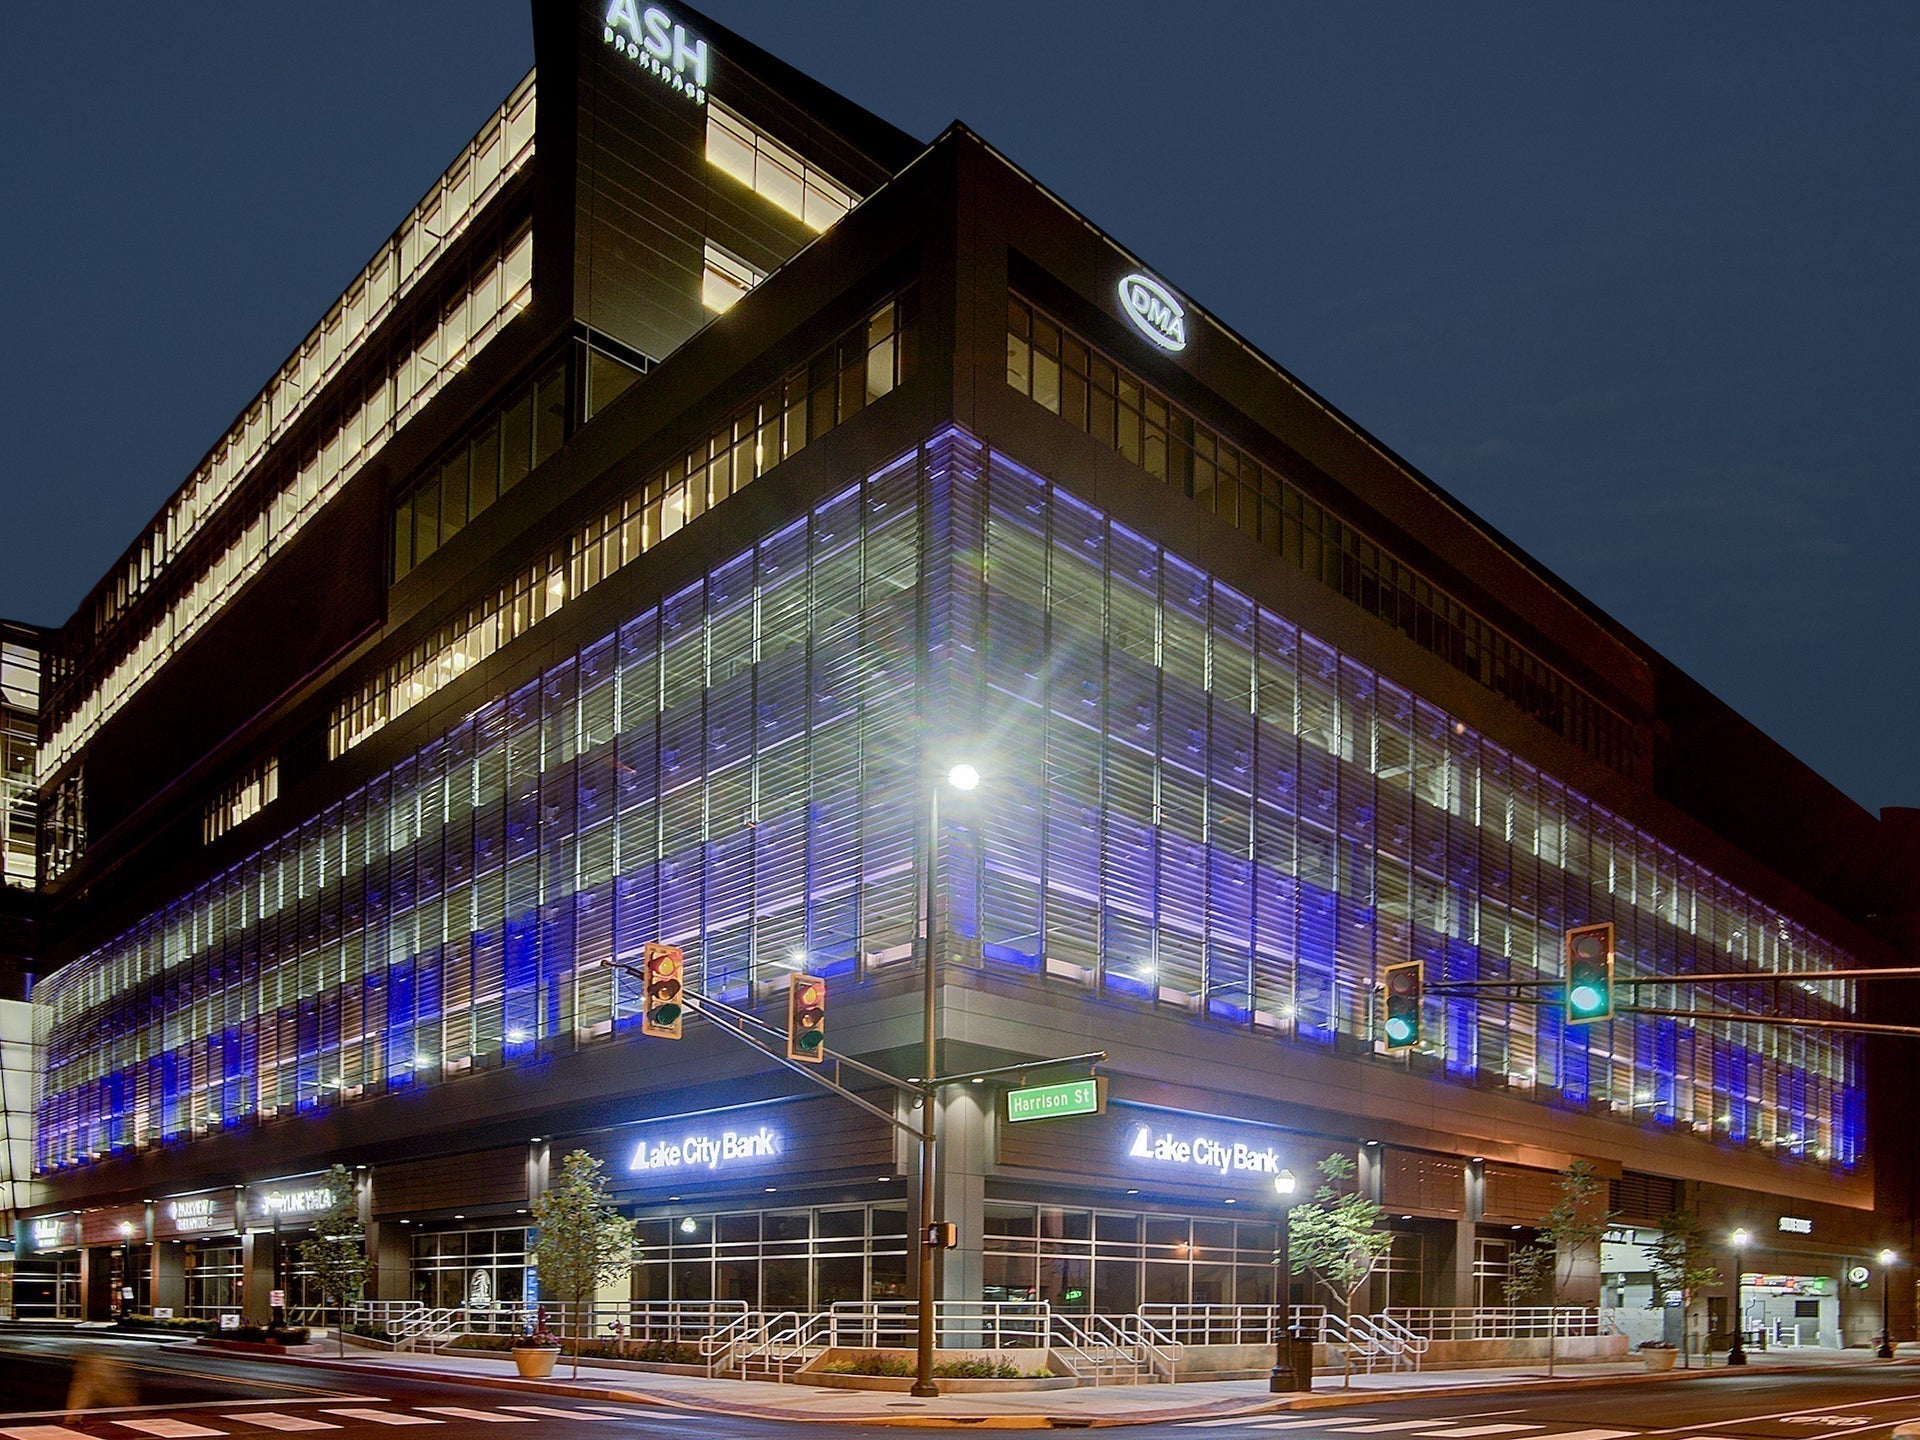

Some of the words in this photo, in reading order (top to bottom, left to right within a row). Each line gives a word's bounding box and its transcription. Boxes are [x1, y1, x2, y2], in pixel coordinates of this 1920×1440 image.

[605, 0, 709, 88] ASH
[1131, 284, 1186, 344] DMA
[1013, 1094, 1069, 1113] Harrison
[1074, 1087, 1090, 1104] St
[629, 1140, 681, 1170] Lake
[682, 1136, 722, 1170] City
[722, 1126, 775, 1160] Bank
[1129, 1127, 1191, 1163] Lake
[1192, 1137, 1233, 1175] City
[1233, 1142, 1280, 1174] Bank
